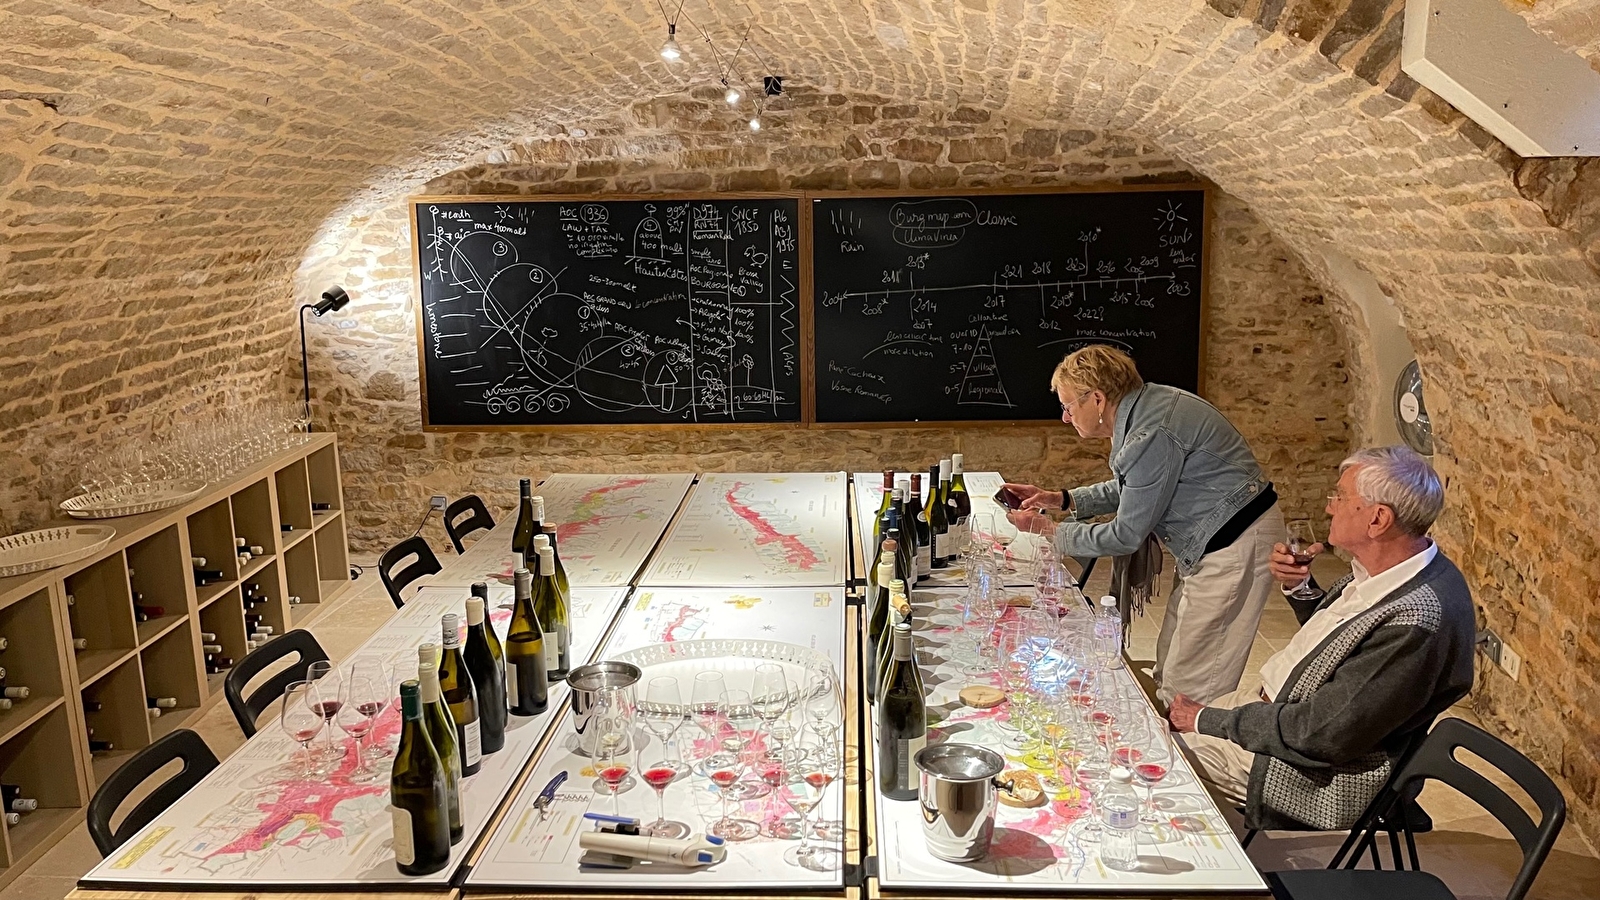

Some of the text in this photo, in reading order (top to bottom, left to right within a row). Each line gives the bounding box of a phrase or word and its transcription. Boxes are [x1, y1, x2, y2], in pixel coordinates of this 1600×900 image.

[559, 205, 606, 221] AOC 1936
[731, 206, 759, 222] SNCF
[977, 210, 1018, 226] Classic
[561, 223, 582, 233] LAW
[591, 225, 608, 233] TAX
[733, 221, 760, 236] 1850
[638, 232, 662, 240] above
[840, 240, 865, 253] Rain
[1166, 280, 1191, 297] 2003
[913, 298, 937, 313] 2014
[983, 295, 1006, 308] 2017
[1038, 318, 1062, 331] 2012
